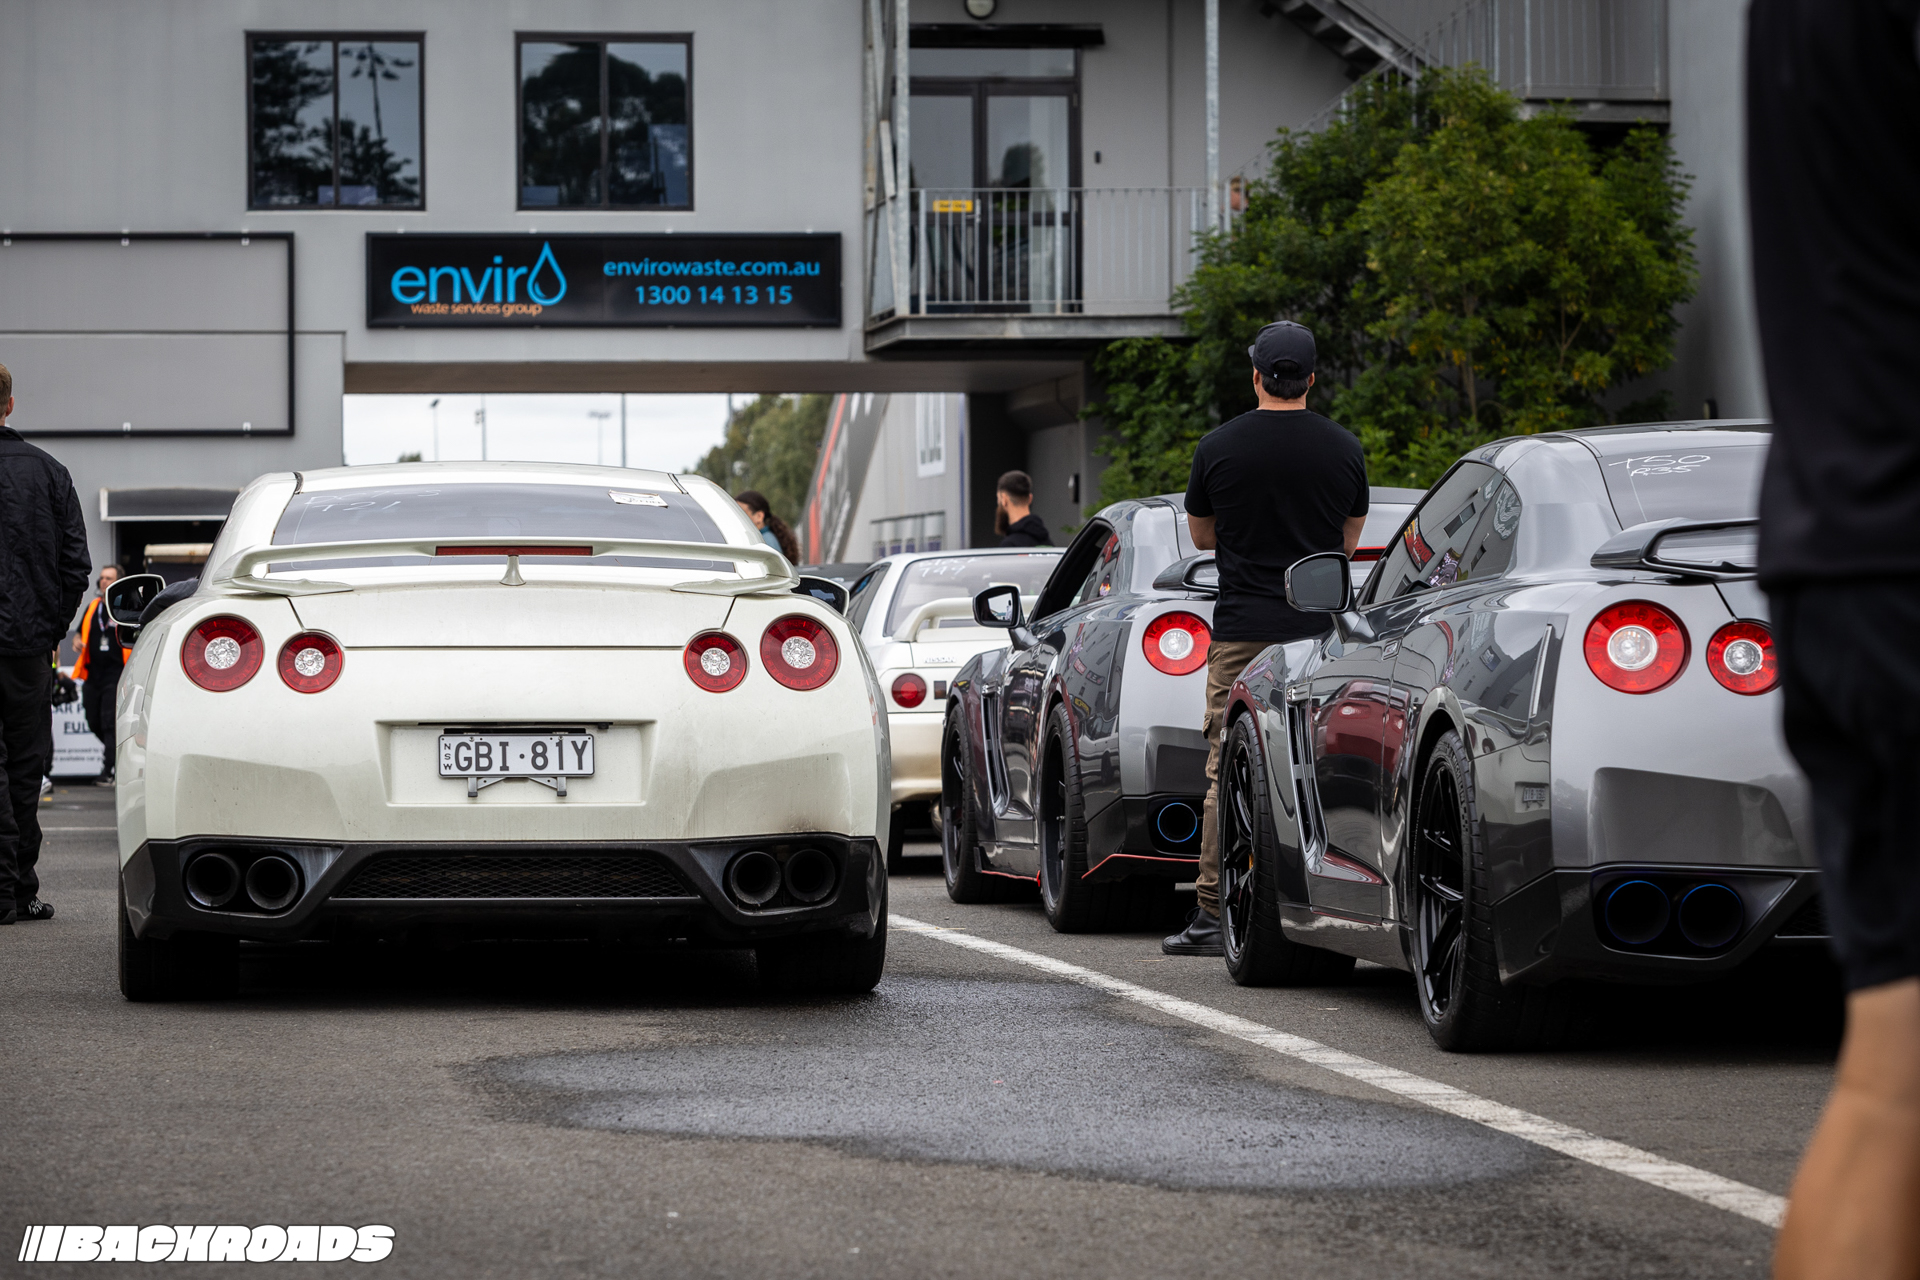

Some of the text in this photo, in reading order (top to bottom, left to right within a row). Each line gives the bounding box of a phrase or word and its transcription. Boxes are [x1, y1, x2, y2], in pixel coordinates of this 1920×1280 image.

[603, 257, 821, 277] envirowaste.com.au
[636, 285, 793, 305] 1300 14 13 15
[410, 302, 543, 318] waste services group
[63, 721, 92, 735] FUL
